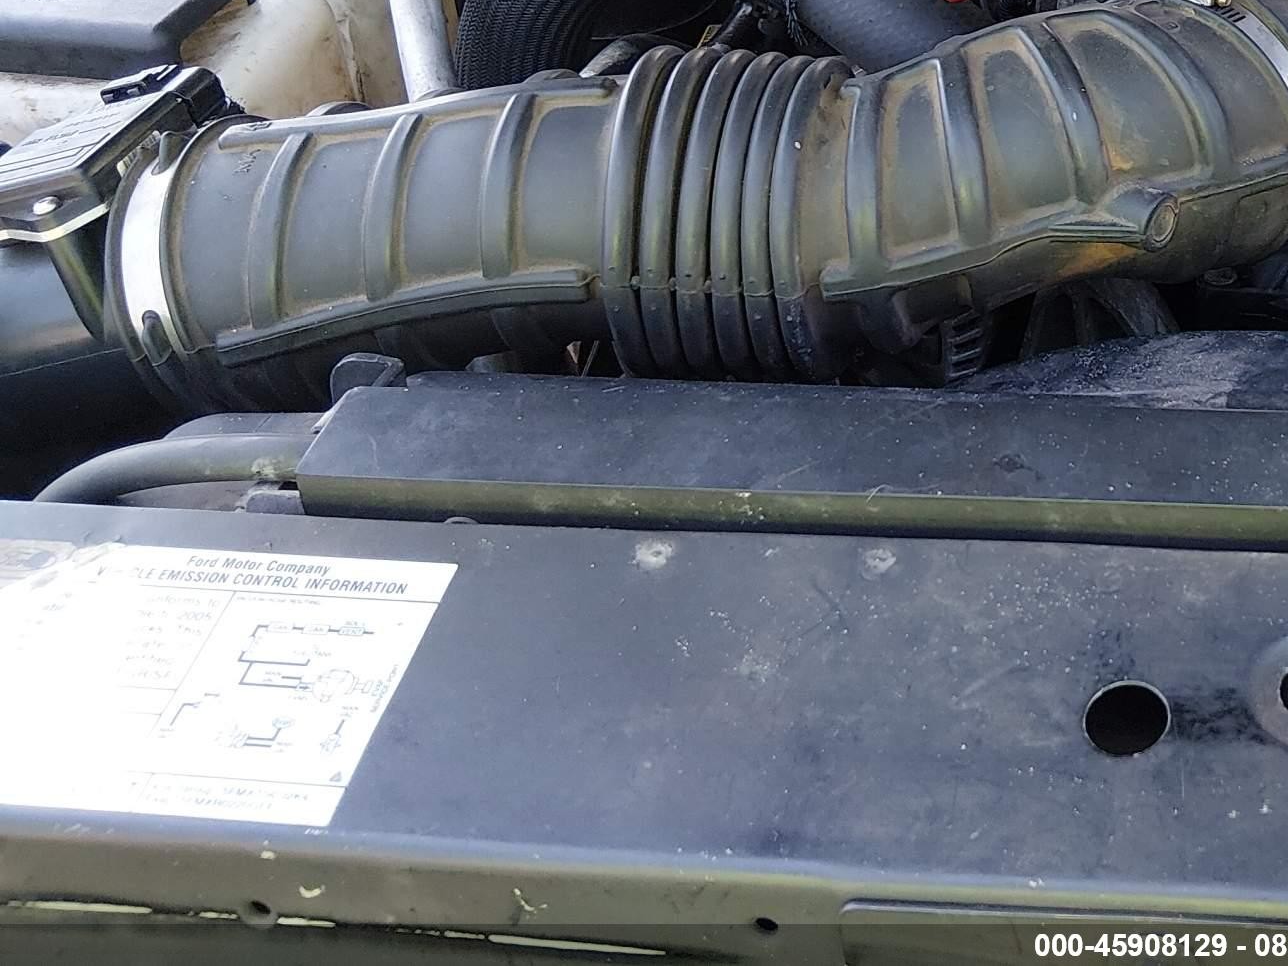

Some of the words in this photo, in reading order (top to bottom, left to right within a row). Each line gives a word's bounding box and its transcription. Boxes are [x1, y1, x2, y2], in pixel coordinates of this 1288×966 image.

[187, 555, 219, 568] Ford
[222, 557, 263, 572] Motor
[266, 560, 331, 577] Company
[158, 568, 230, 584] EMISSION
[233, 573, 298, 589] CONTROL
[305, 579, 409, 595] INFORMATION
